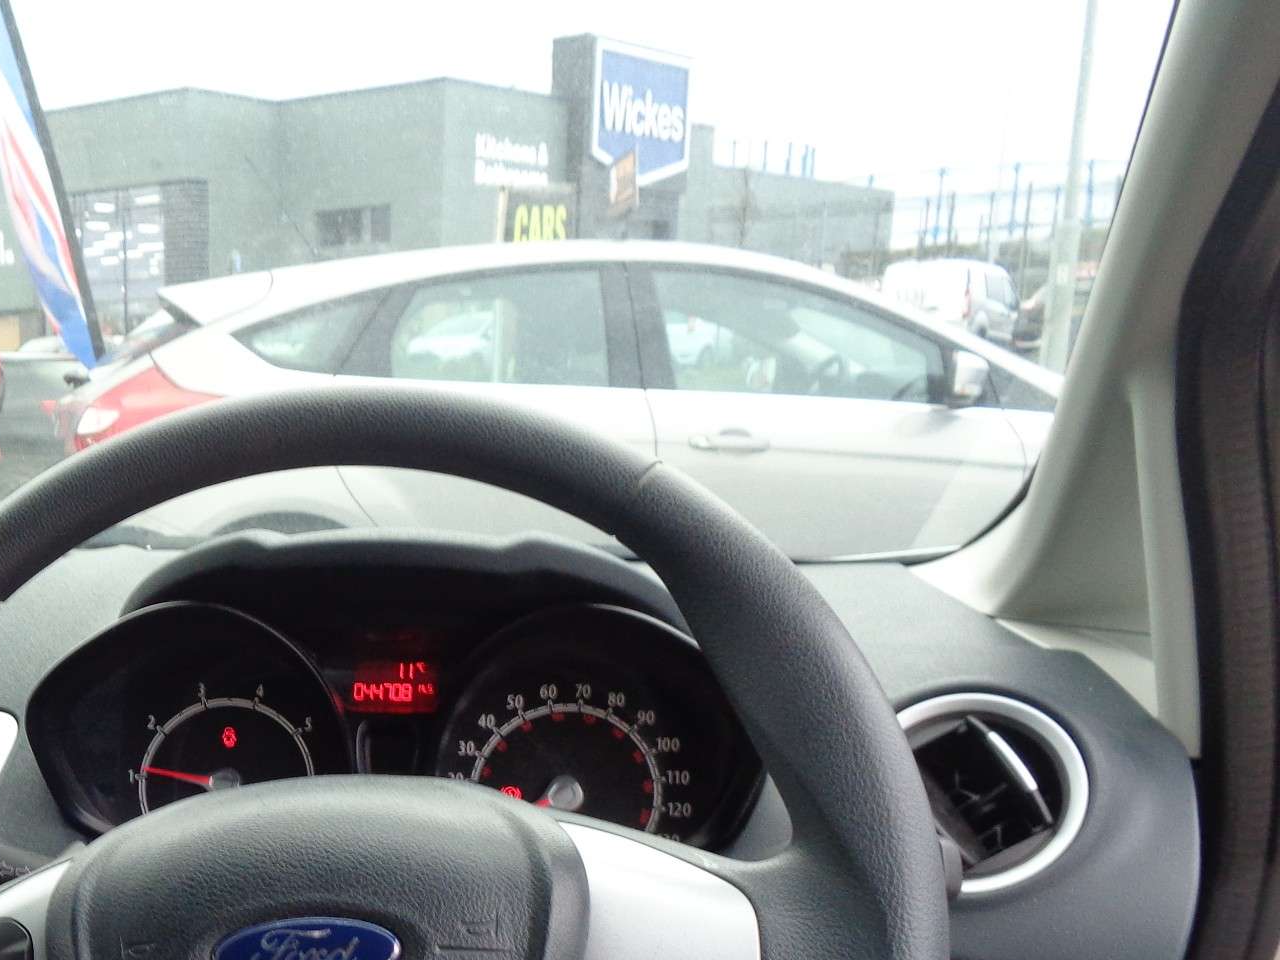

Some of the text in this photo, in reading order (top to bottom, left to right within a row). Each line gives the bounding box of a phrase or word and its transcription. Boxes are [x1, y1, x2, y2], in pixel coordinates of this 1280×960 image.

[602, 79, 685, 143] Wickes
[513, 204, 568, 244] CARS
[539, 683, 557, 699] 60
[575, 683, 592, 699] 70
[607, 691, 625, 708] 80
[506, 693, 524, 710] 50
[477, 713, 496, 730] 40
[636, 709, 656, 725] 90
[457, 740, 475, 757] 30
[656, 736, 681, 753] 100
[665, 769, 691, 785] 110
[668, 802, 692, 818] 120
